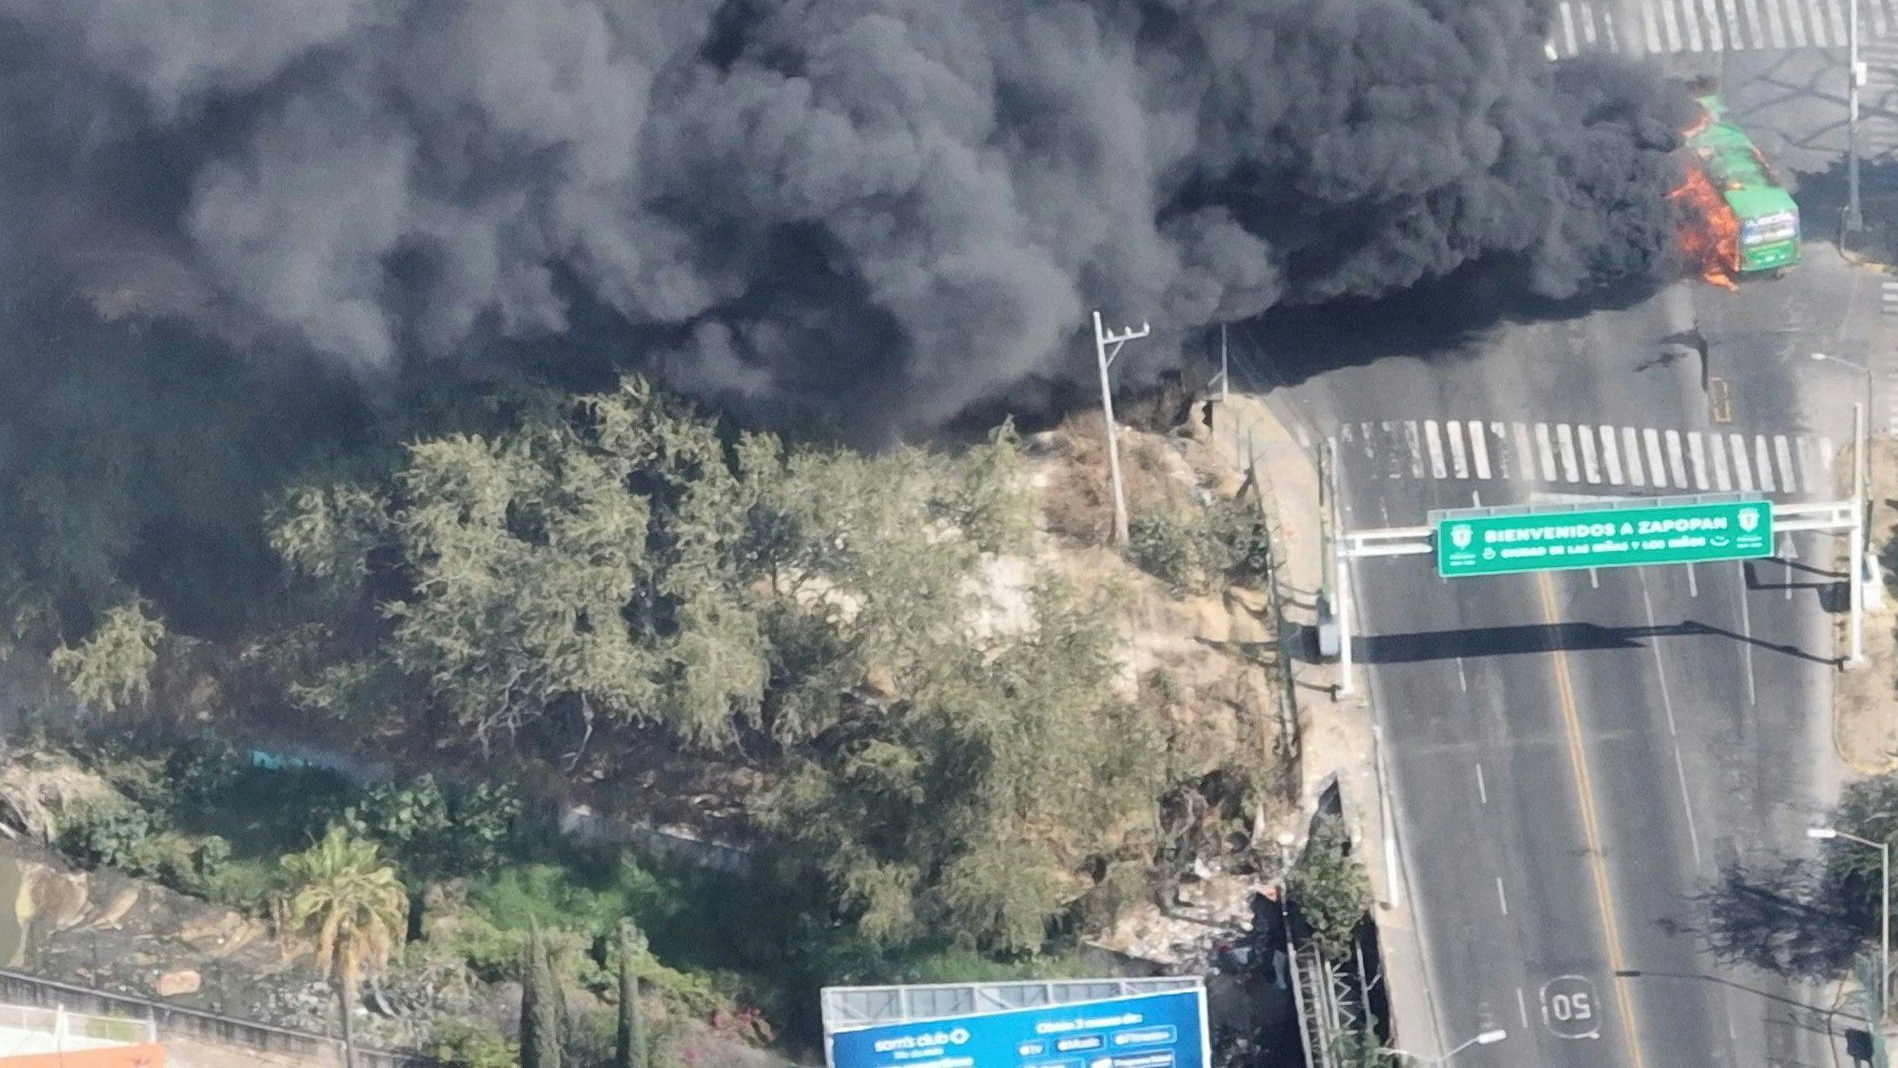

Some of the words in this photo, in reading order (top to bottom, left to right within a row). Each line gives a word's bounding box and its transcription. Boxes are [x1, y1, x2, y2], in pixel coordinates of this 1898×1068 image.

[1484, 522, 1616, 543] BIENVENIDOS
[1620, 521, 1634, 535] A
[1637, 516, 1728, 534] ZAPOPAN
